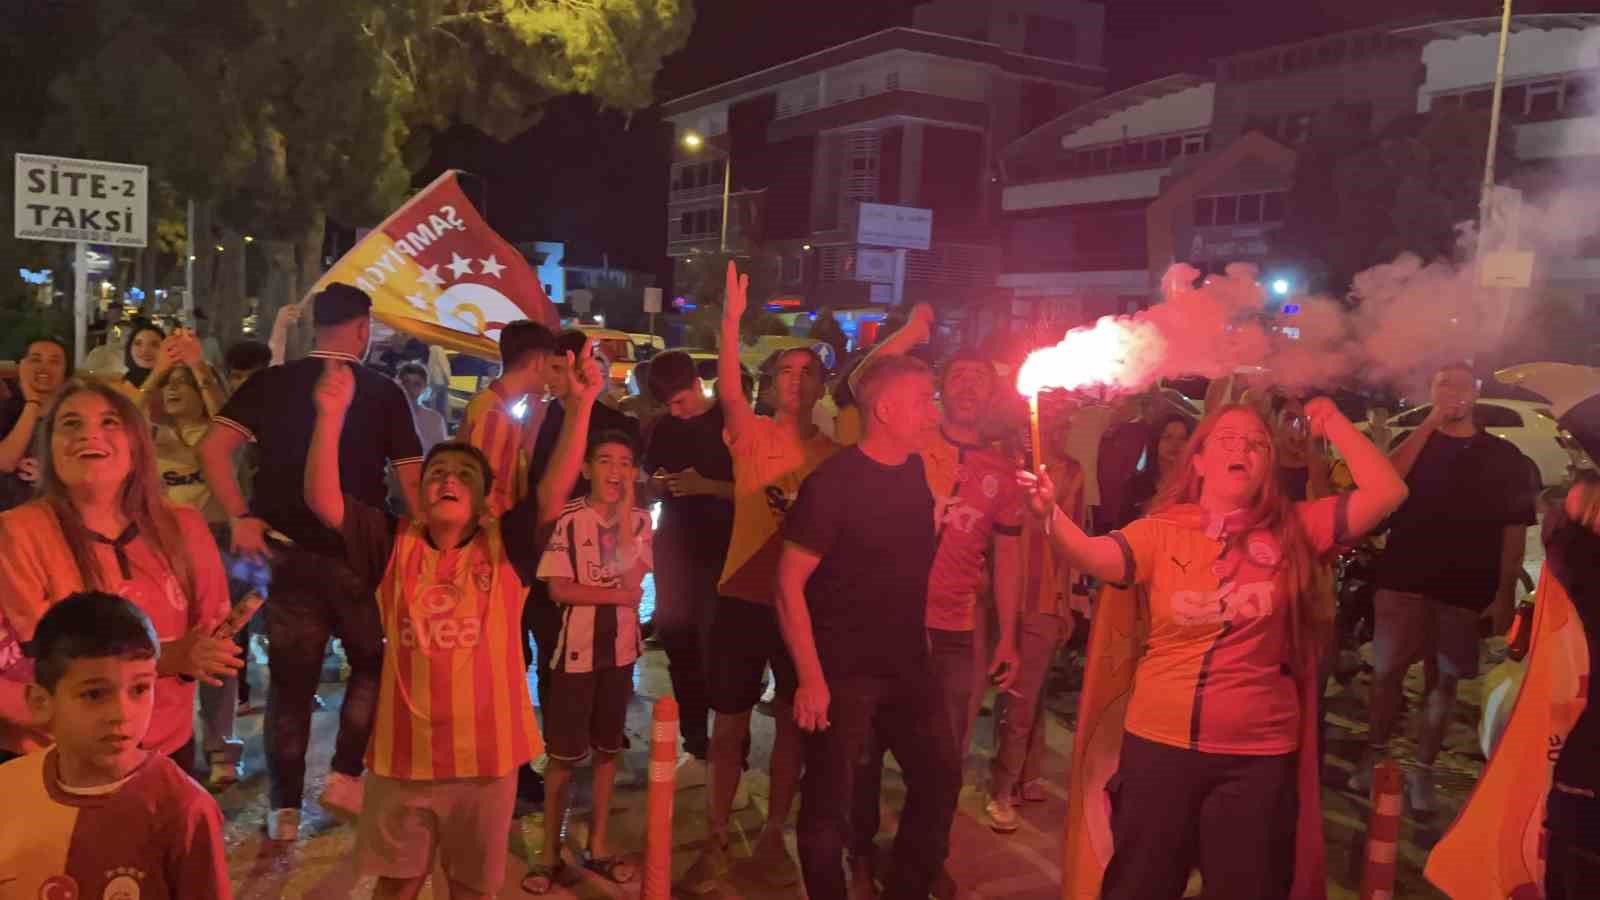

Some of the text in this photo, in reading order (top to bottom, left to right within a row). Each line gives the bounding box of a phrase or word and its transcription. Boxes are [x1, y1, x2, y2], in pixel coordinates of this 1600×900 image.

[28, 164, 135, 200] SİTE-2
[26, 204, 132, 233] TAKSİ
[401, 616, 481, 656] avea
